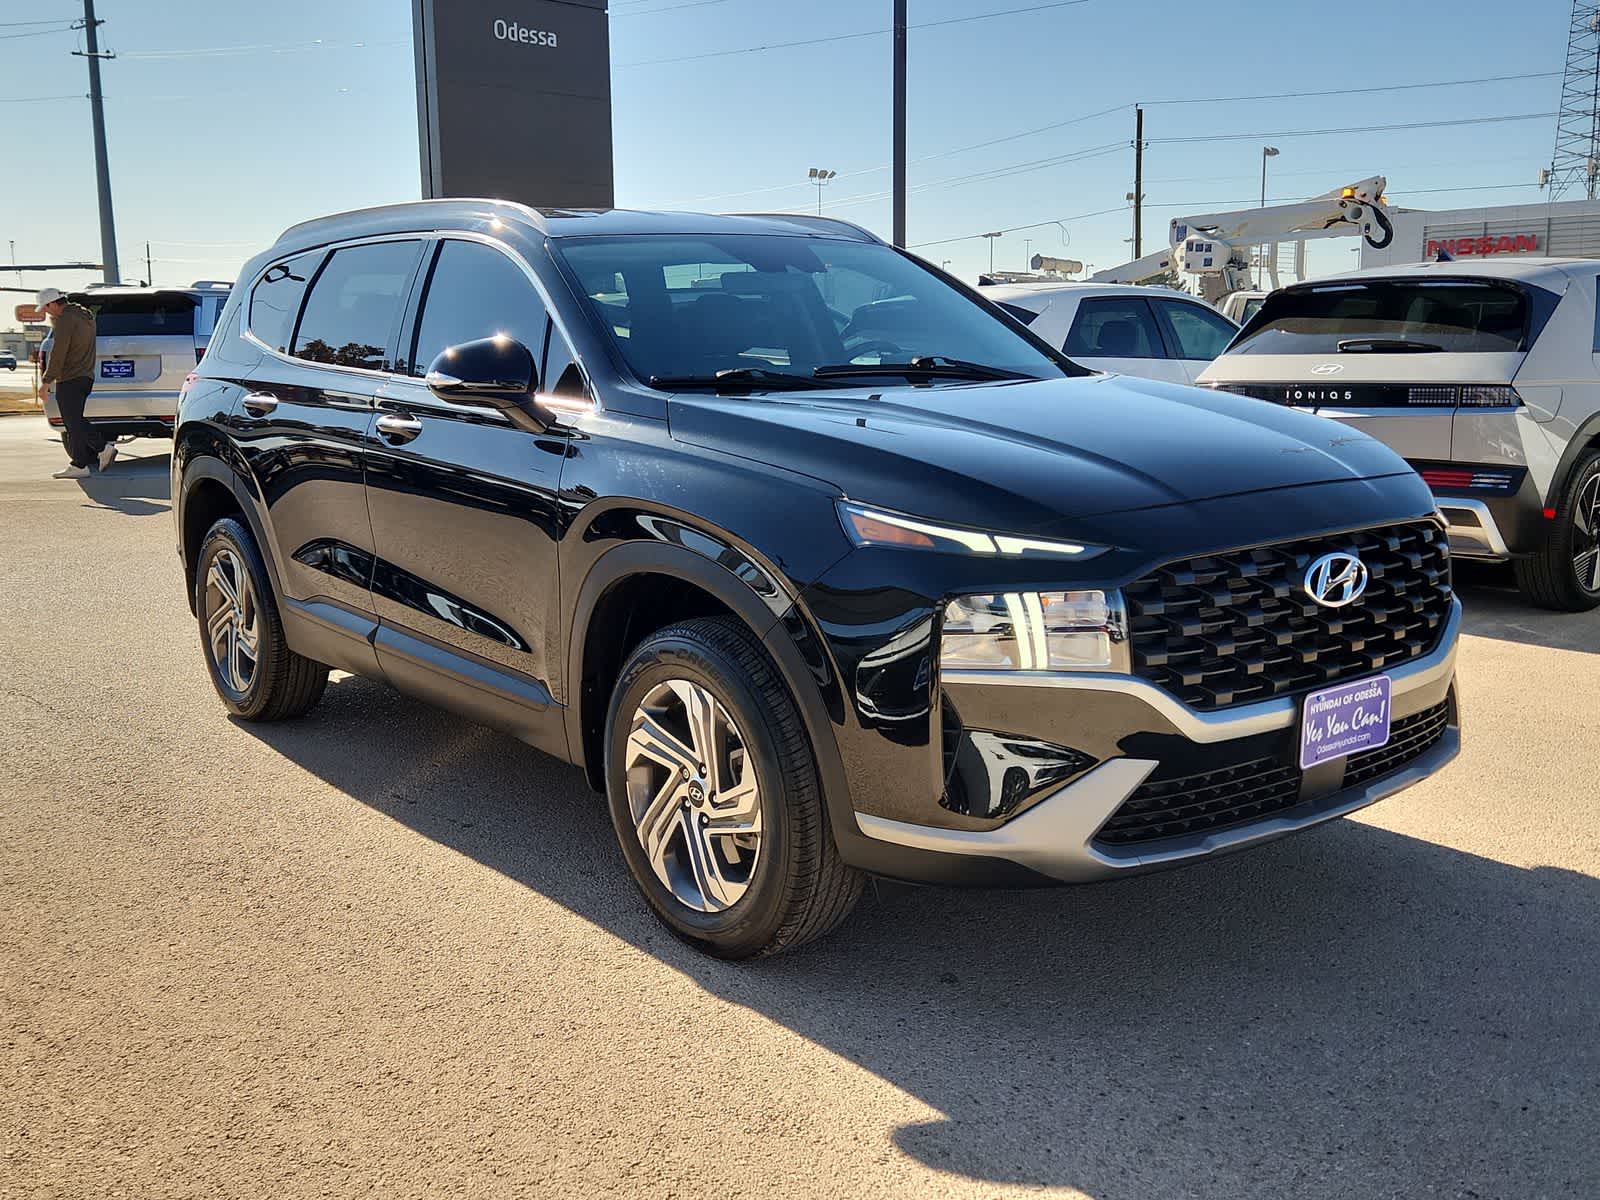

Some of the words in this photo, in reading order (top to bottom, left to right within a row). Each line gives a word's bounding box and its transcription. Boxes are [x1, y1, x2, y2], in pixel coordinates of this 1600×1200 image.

[493, 19, 558, 48] Odessa
[1426, 233, 1537, 256] NISSAN
[1285, 390, 1338, 400] IONIQ
[1344, 390, 1352, 400] 5
[1310, 697, 1342, 715] HYUNDAI
[1342, 693, 1353, 705] OF
[1354, 688, 1383, 702] ODESSA
[1305, 719, 1324, 745] Yes
[1326, 713, 1349, 739] You
[1351, 699, 1385, 730] Can!
